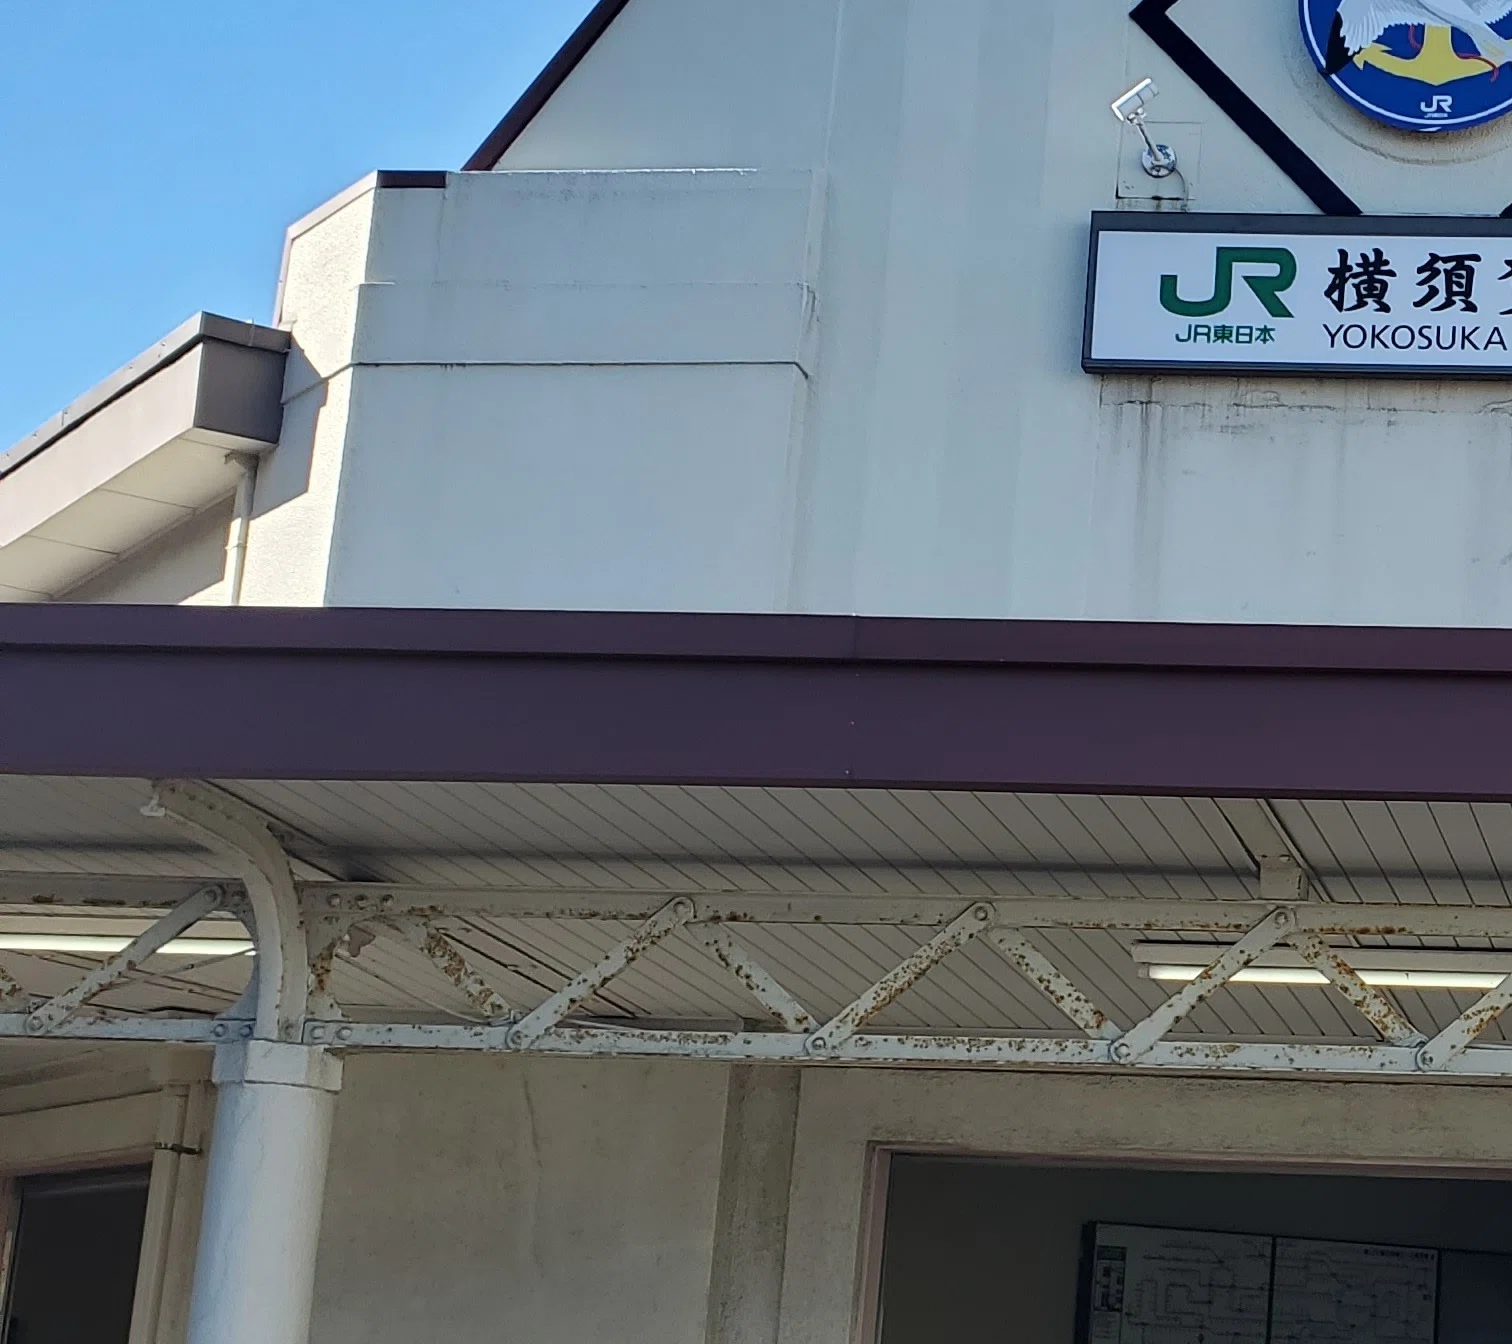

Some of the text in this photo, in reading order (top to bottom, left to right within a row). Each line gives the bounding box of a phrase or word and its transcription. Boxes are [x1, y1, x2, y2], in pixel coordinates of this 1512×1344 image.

[1420, 95, 1453, 113] JR
[1160, 246, 1298, 319] JR
[1175, 324, 1276, 345] JR東日本
[1323, 323, 1509, 352] YOKOSUKA
